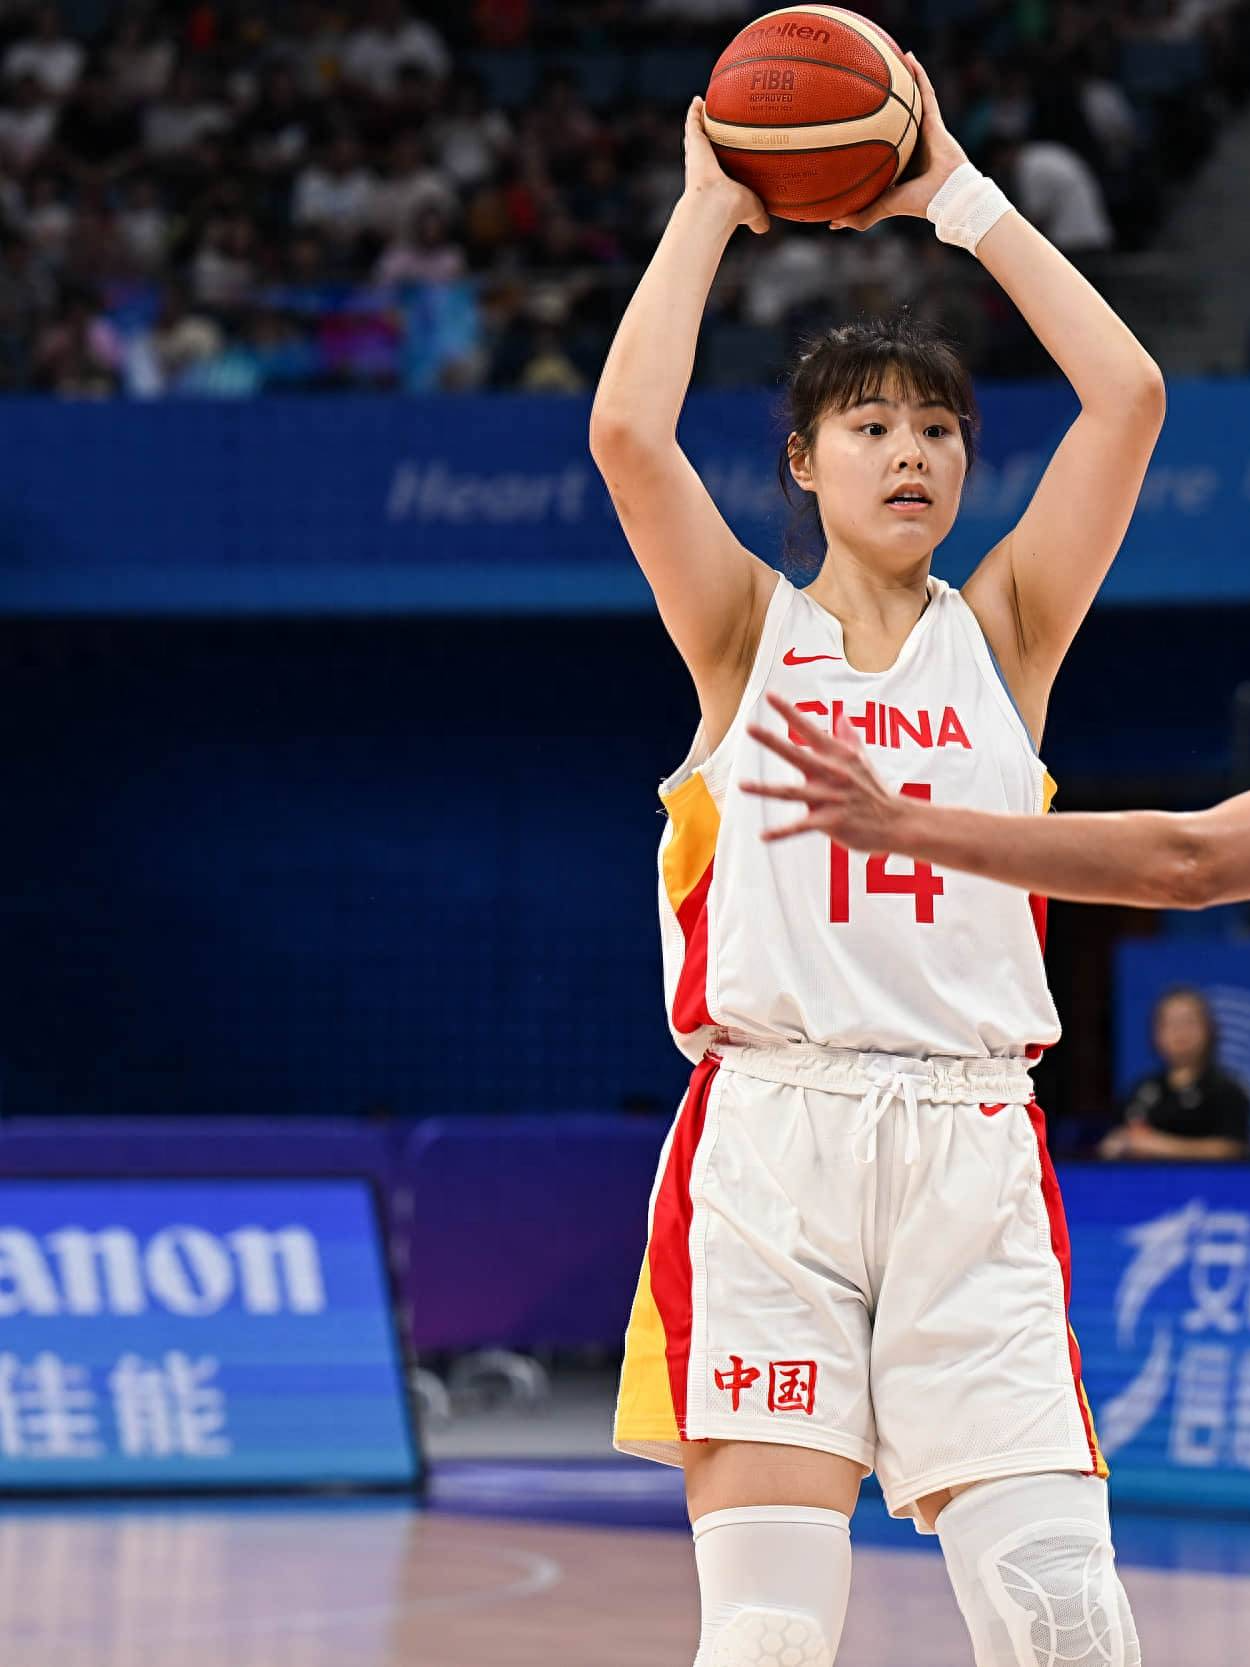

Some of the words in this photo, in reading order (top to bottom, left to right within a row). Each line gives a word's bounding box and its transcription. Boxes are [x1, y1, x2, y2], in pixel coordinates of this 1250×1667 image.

[744, 23, 831, 44] molten
[751, 70, 795, 91] FIBA
[749, 94, 793, 103] APPROVED
[829, 782, 944, 923] 14
[714, 1355, 818, 1415] 中国
